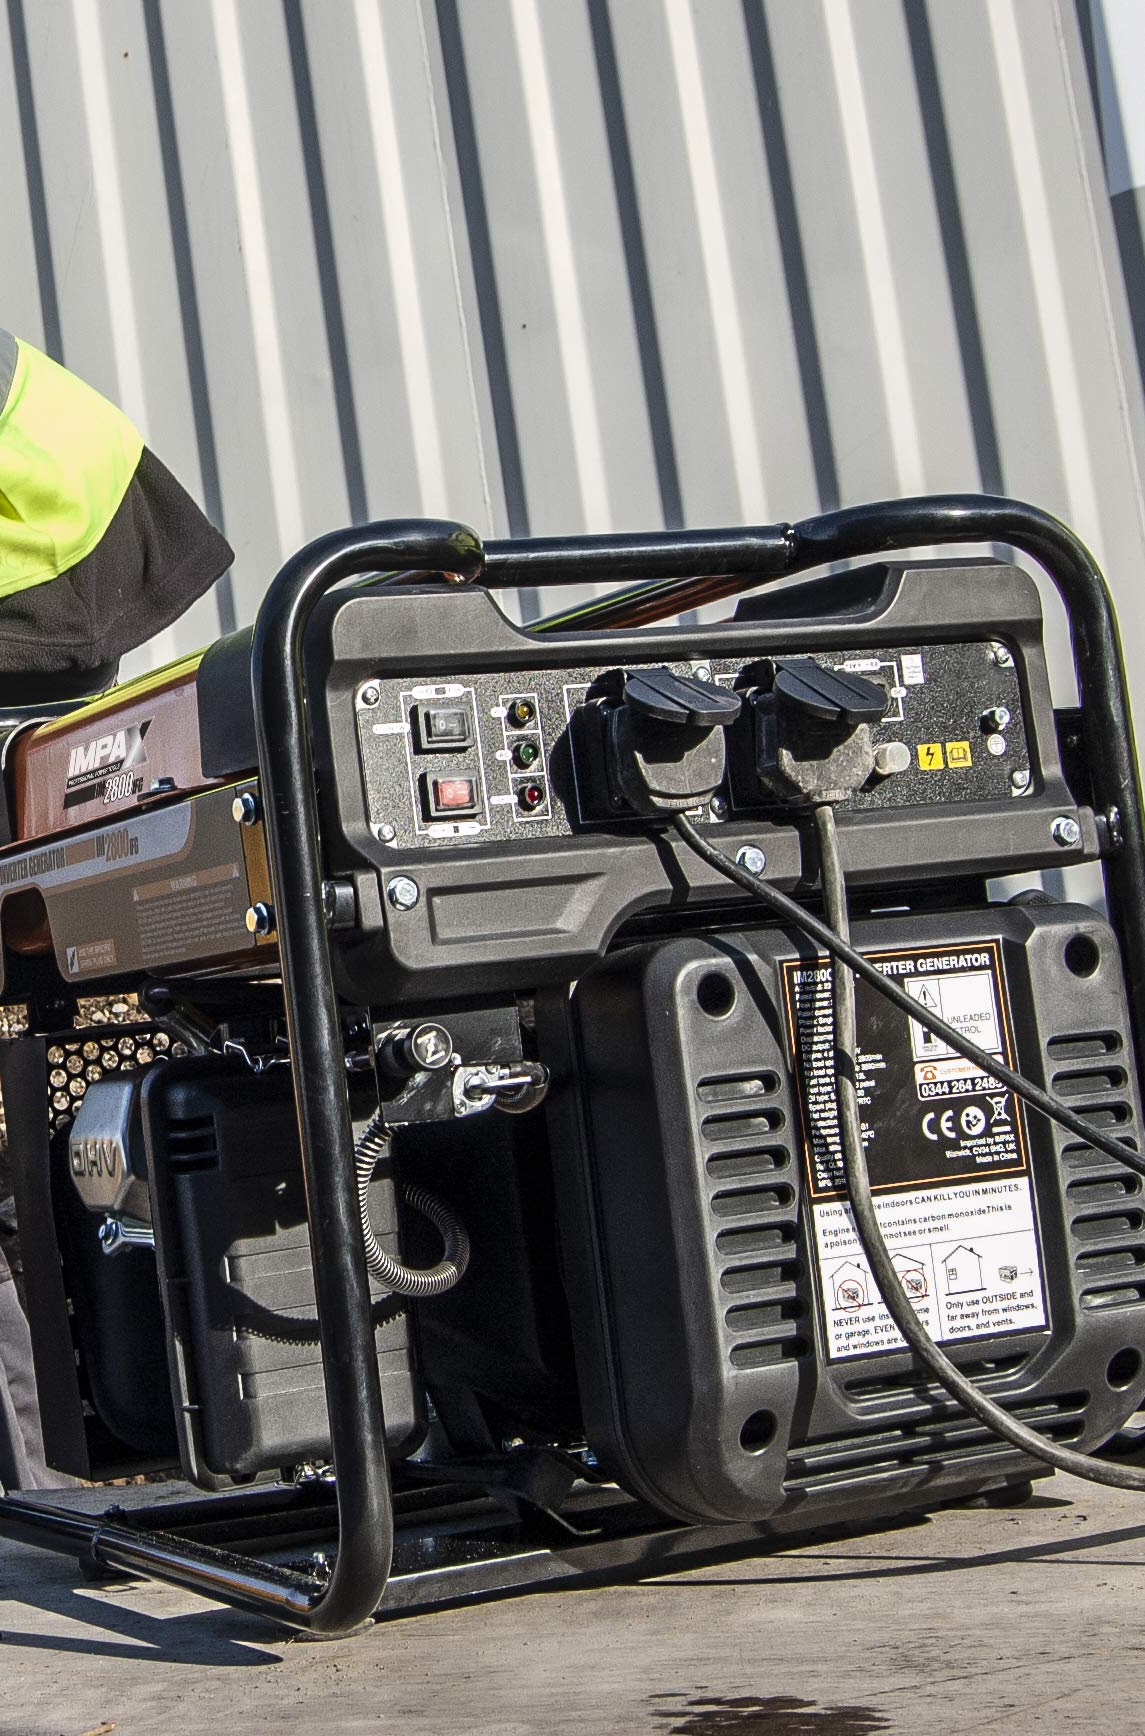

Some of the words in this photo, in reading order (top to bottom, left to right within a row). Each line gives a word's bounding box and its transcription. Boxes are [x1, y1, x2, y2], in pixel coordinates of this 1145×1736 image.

[67, 717, 155, 778] IMPAX
[916, 953, 990, 972] GENERATOR
[947, 1012, 990, 1024] UNLEADED
[922, 1082, 949, 1096] 0344
[952, 1079, 972, 1093] 264
[71, 1140, 117, 1177] OHV
[819, 1207, 843, 1218] Using
[914, 1195, 932, 1205] CAN
[933, 1192, 952, 1202] KILL
[953, 1190, 971, 1199] YOU
[972, 1188, 981, 1197] IN
[981, 1183, 1022, 1196] MINUTES.
[822, 1227, 850, 1237] Engine
[883, 1217, 916, 1228] contains
[918, 1213, 946, 1224] carbon
[903, 1229, 916, 1238] see
[918, 1227, 926, 1235] or
[945, 1301, 963, 1310] Only
[965, 1299, 979, 1307] use
[981, 1291, 1017, 1305] OUTSIDE
[1019, 1290, 1033, 1299] and
[833, 1316, 860, 1328] NEVER
[862, 1315, 875, 1323] use
[947, 1313, 957, 1321] far
[959, 1310, 979, 1320] away
[981, 1307, 999, 1317] from
[834, 1332, 842, 1340] or
[874, 1323, 895, 1334] EVEN
[976, 1320, 990, 1329] and
[836, 1344, 849, 1353] and
[851, 1339, 884, 1350] windows
[886, 1336, 897, 1345] are
